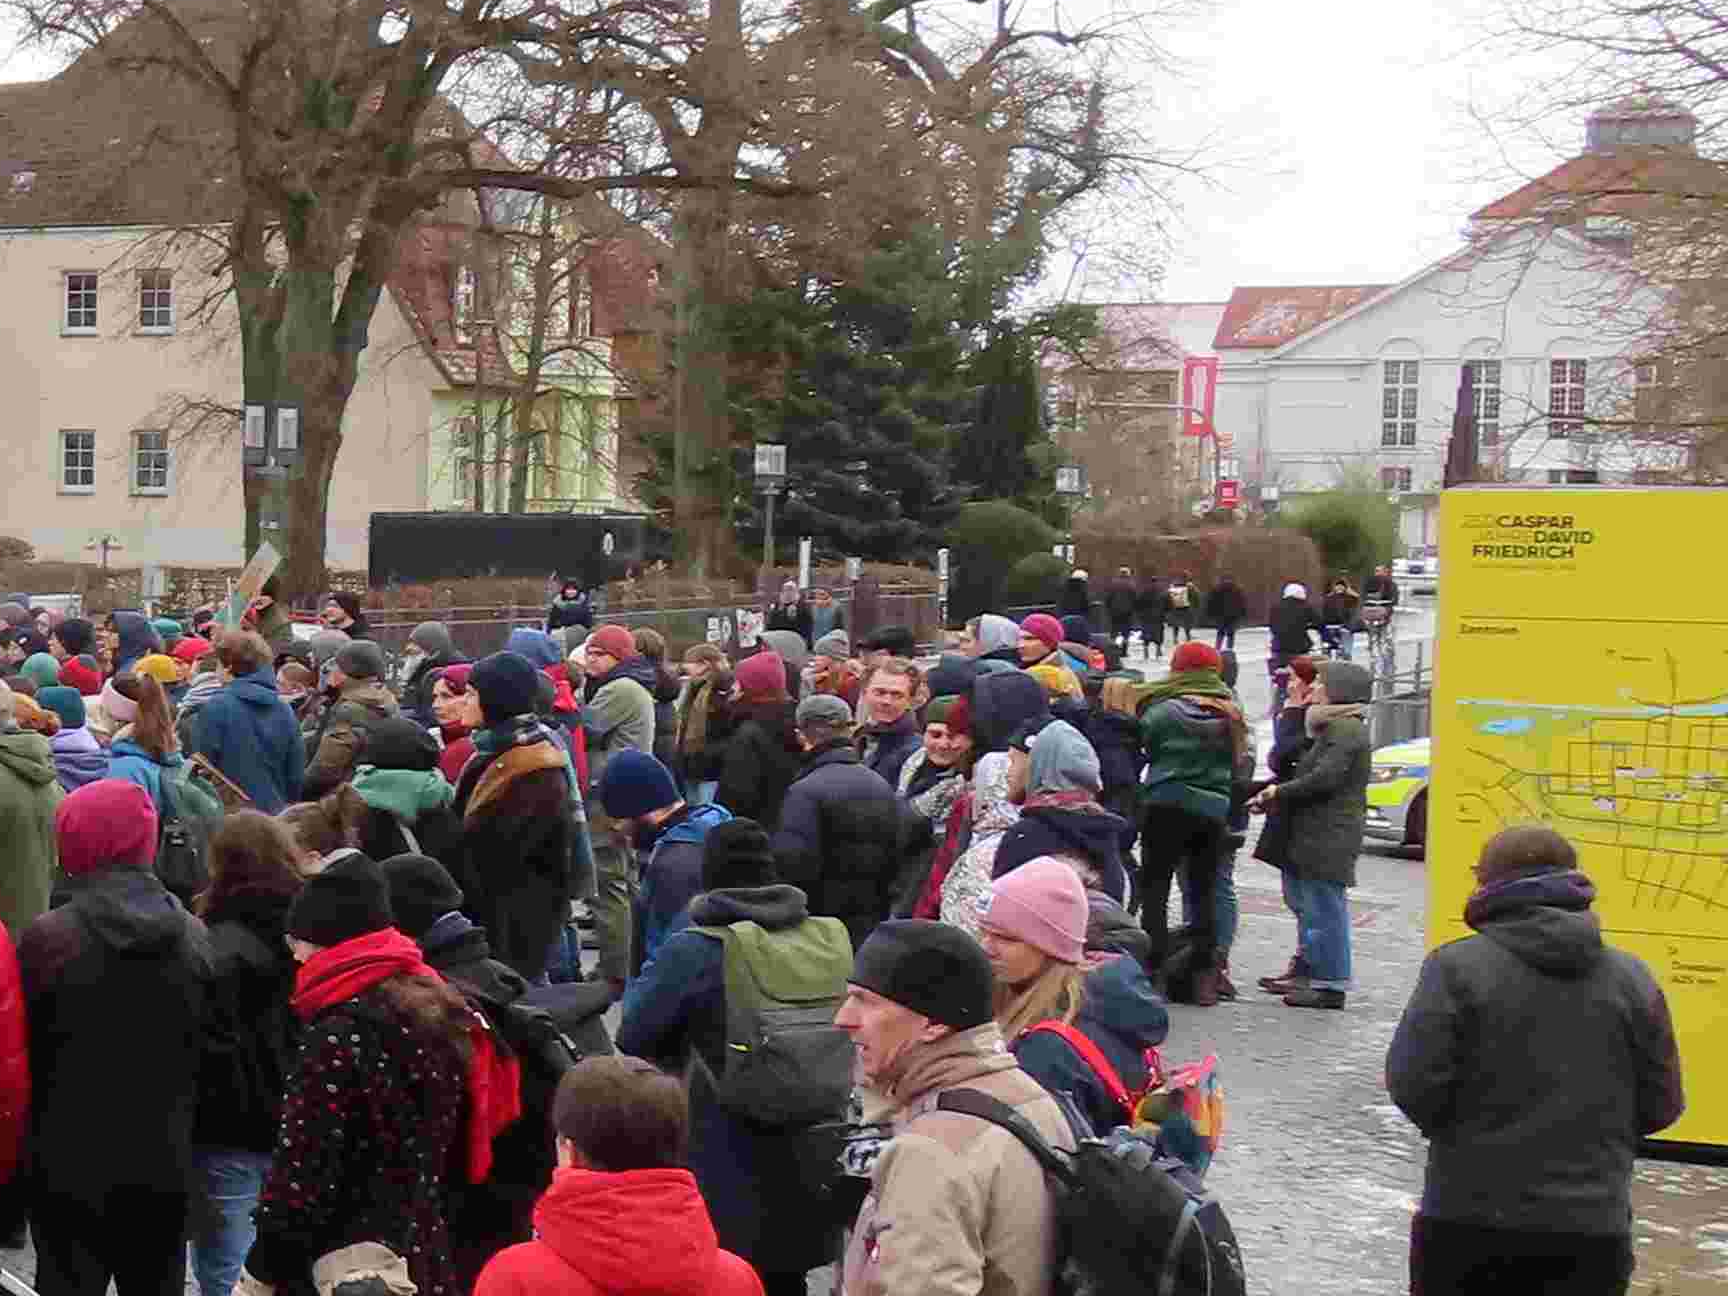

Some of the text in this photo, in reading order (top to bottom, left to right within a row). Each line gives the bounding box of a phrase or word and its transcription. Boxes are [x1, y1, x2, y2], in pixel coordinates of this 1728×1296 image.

[1495, 514, 1575, 529] CASPAR
[1533, 529, 1594, 545] DAVID
[1471, 544, 1575, 559] FRIEDRICH
